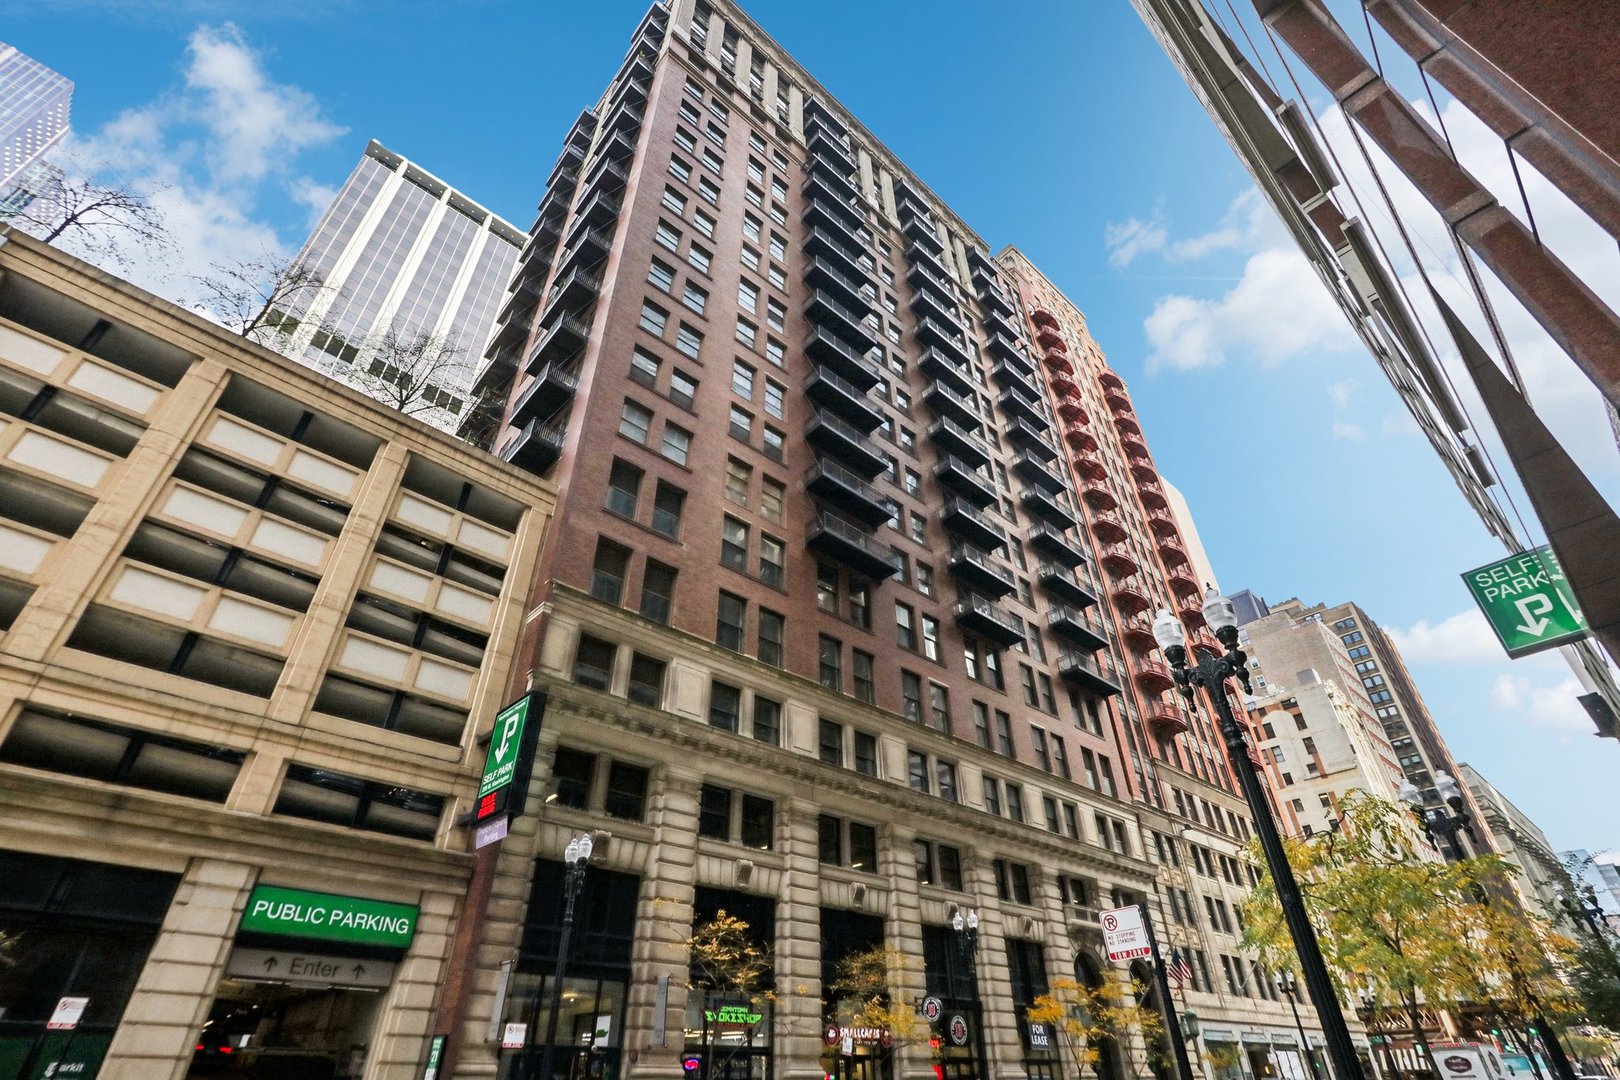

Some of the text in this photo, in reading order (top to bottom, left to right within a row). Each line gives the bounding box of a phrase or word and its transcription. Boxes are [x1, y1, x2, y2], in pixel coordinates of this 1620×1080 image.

[1475, 557, 1534, 587] SELF
[1484, 570, 1550, 603] PARK
[483, 761, 514, 784] SELF PARK
[252, 899, 409, 935] PUBLIC PARKING
[1114, 947, 1145, 960] TOW ZONE
[289, 957, 340, 978] Enter
[1031, 1034, 1048, 1046] LEASE
[1032, 1024, 1044, 1035] FOR
